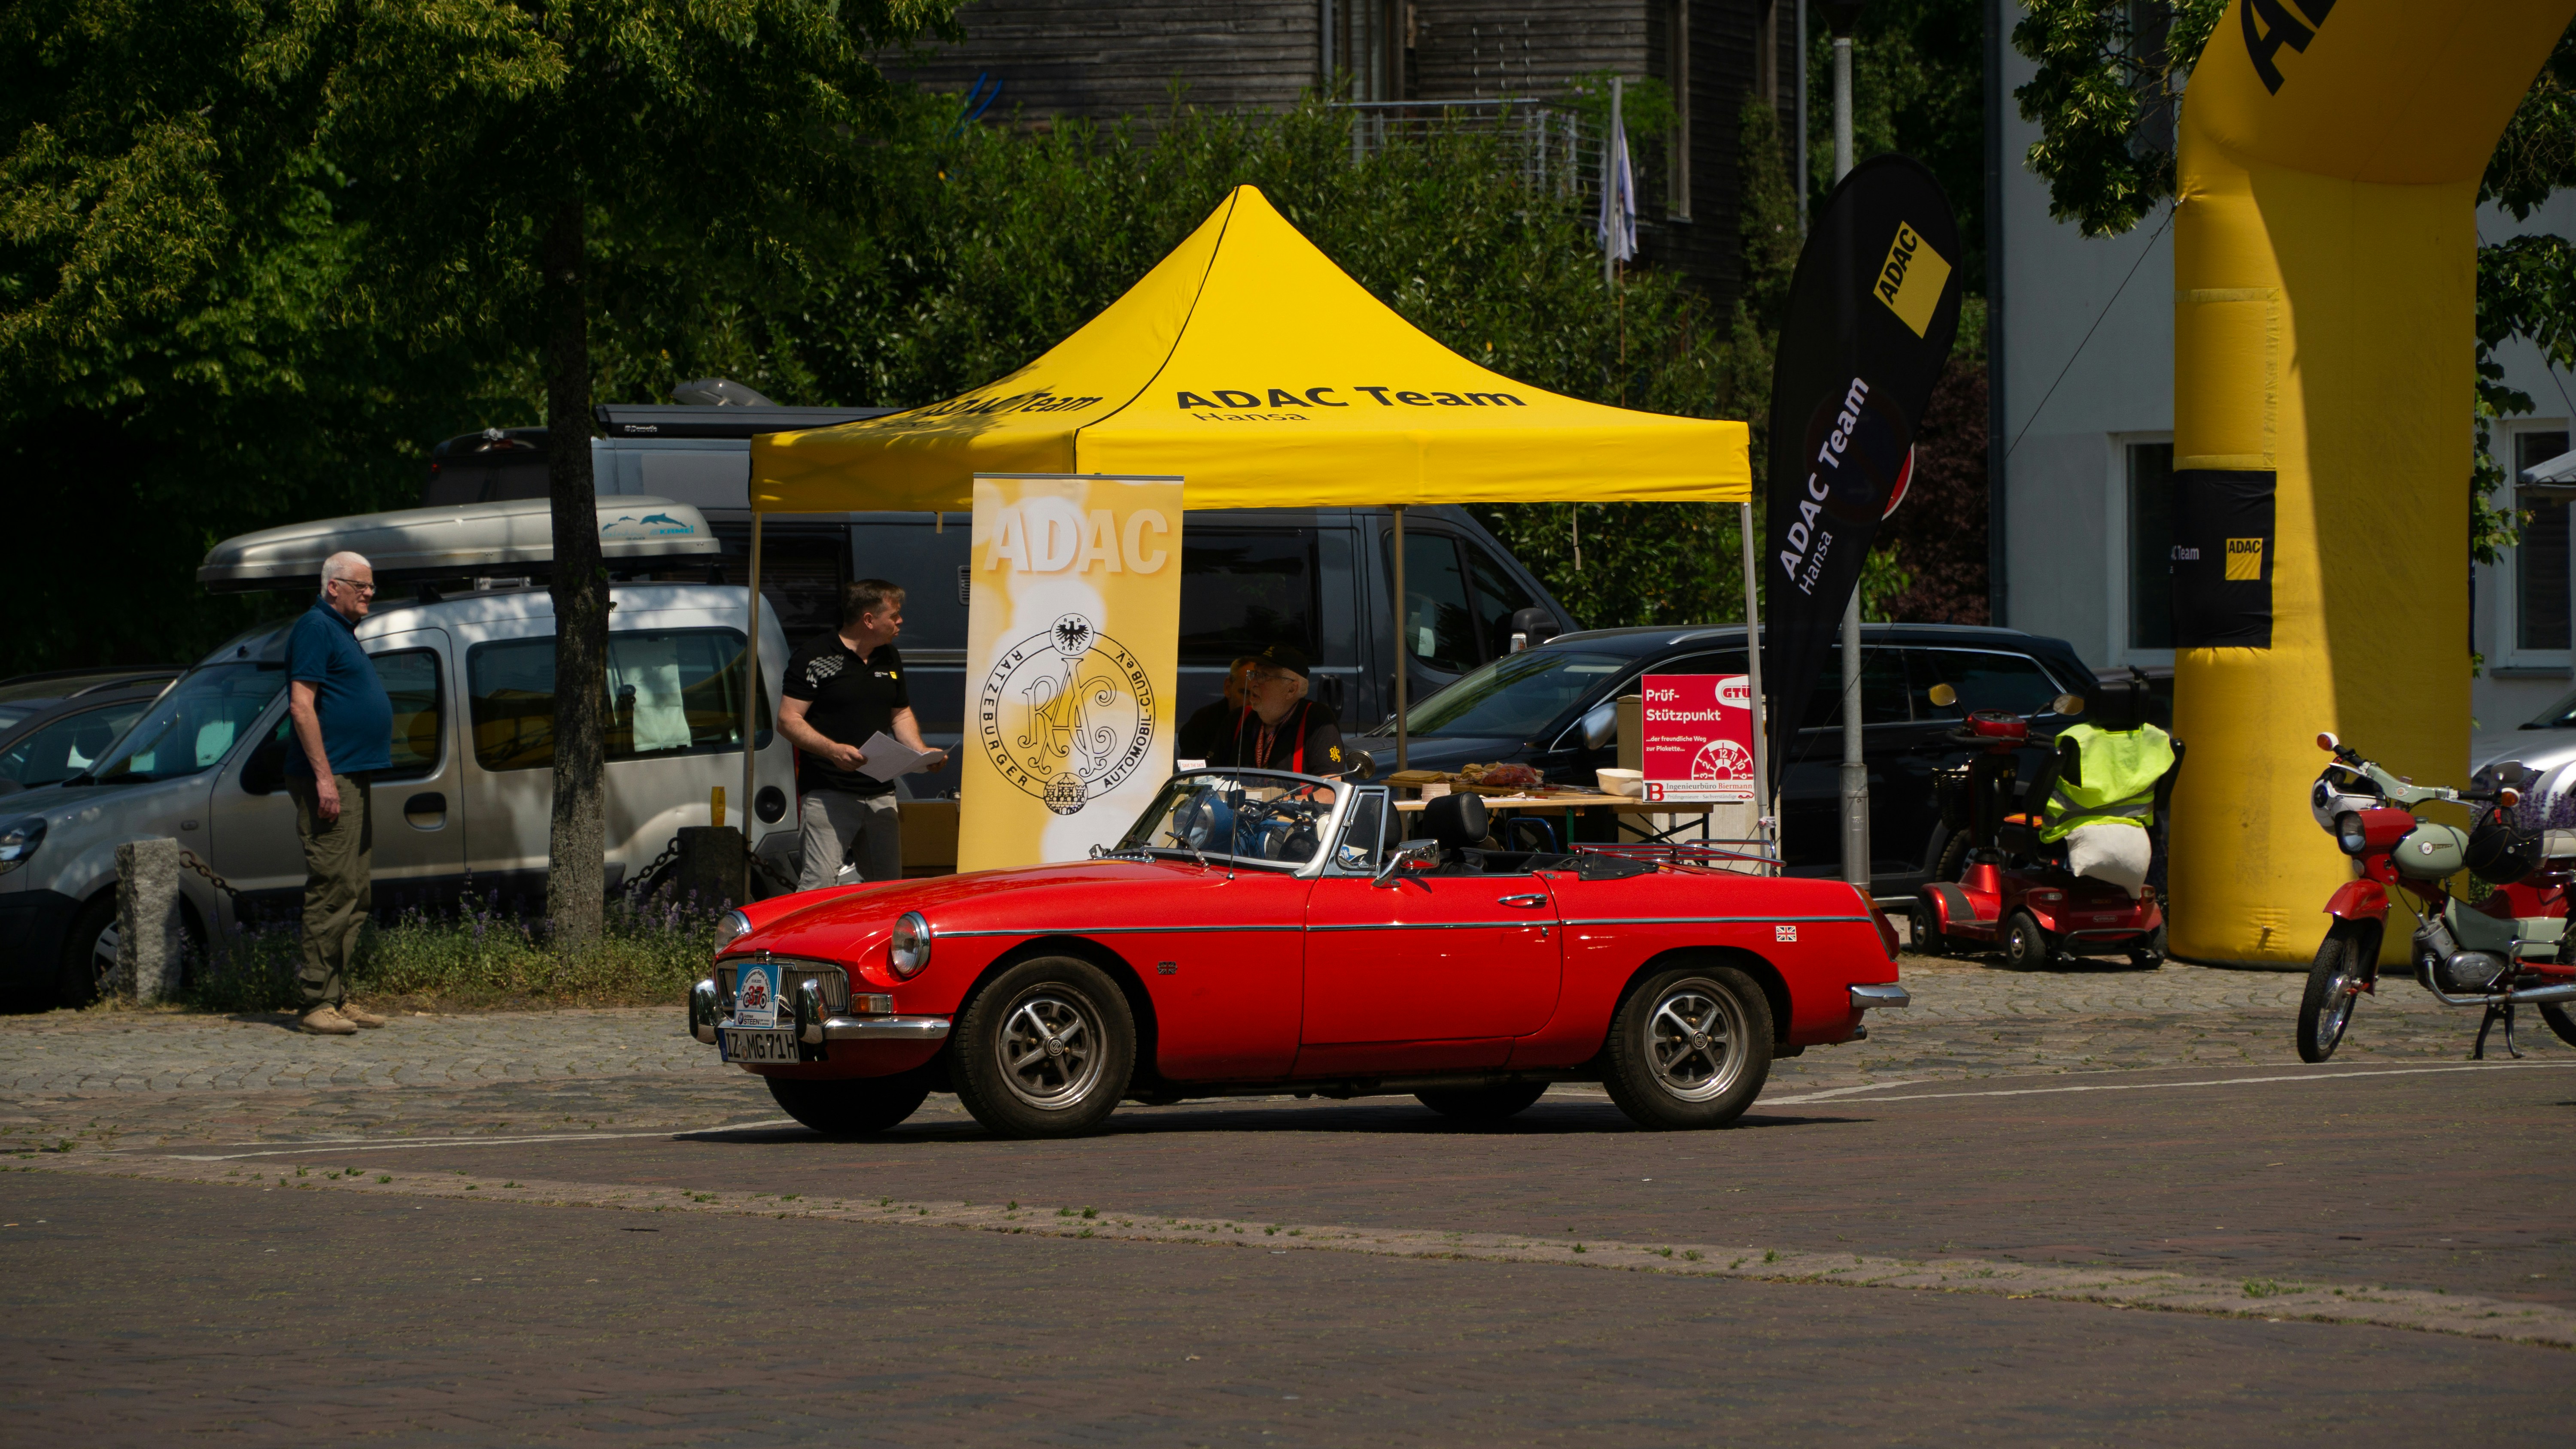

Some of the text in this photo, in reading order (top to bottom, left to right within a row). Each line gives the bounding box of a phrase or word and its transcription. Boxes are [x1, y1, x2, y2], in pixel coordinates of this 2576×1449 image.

[1878, 228, 1917, 305] ADAC
[1005, 392, 1104, 412] Team
[1177, 386, 1528, 409] ADAC Team
[1191, 413, 1311, 421] Hansa
[1779, 377, 1869, 581] ADAC Team
[983, 509, 1168, 574] ADAC
[2228, 540, 2261, 554] ADAC
[2178, 545, 2199, 560] Team
[1798, 531, 1833, 595] Hansa
[1646, 689, 1680, 701] Prüf-
[984, 649, 1028, 787] RATZEBURGER
[1646, 709, 1721, 724] Stützpunkt
[1719, 749, 1728, 758] 12
[1666, 783, 1716, 791] Ingenieurbüro
[747, 985, 764, 1005] 37
[726, 1033, 740, 1058] IZ
